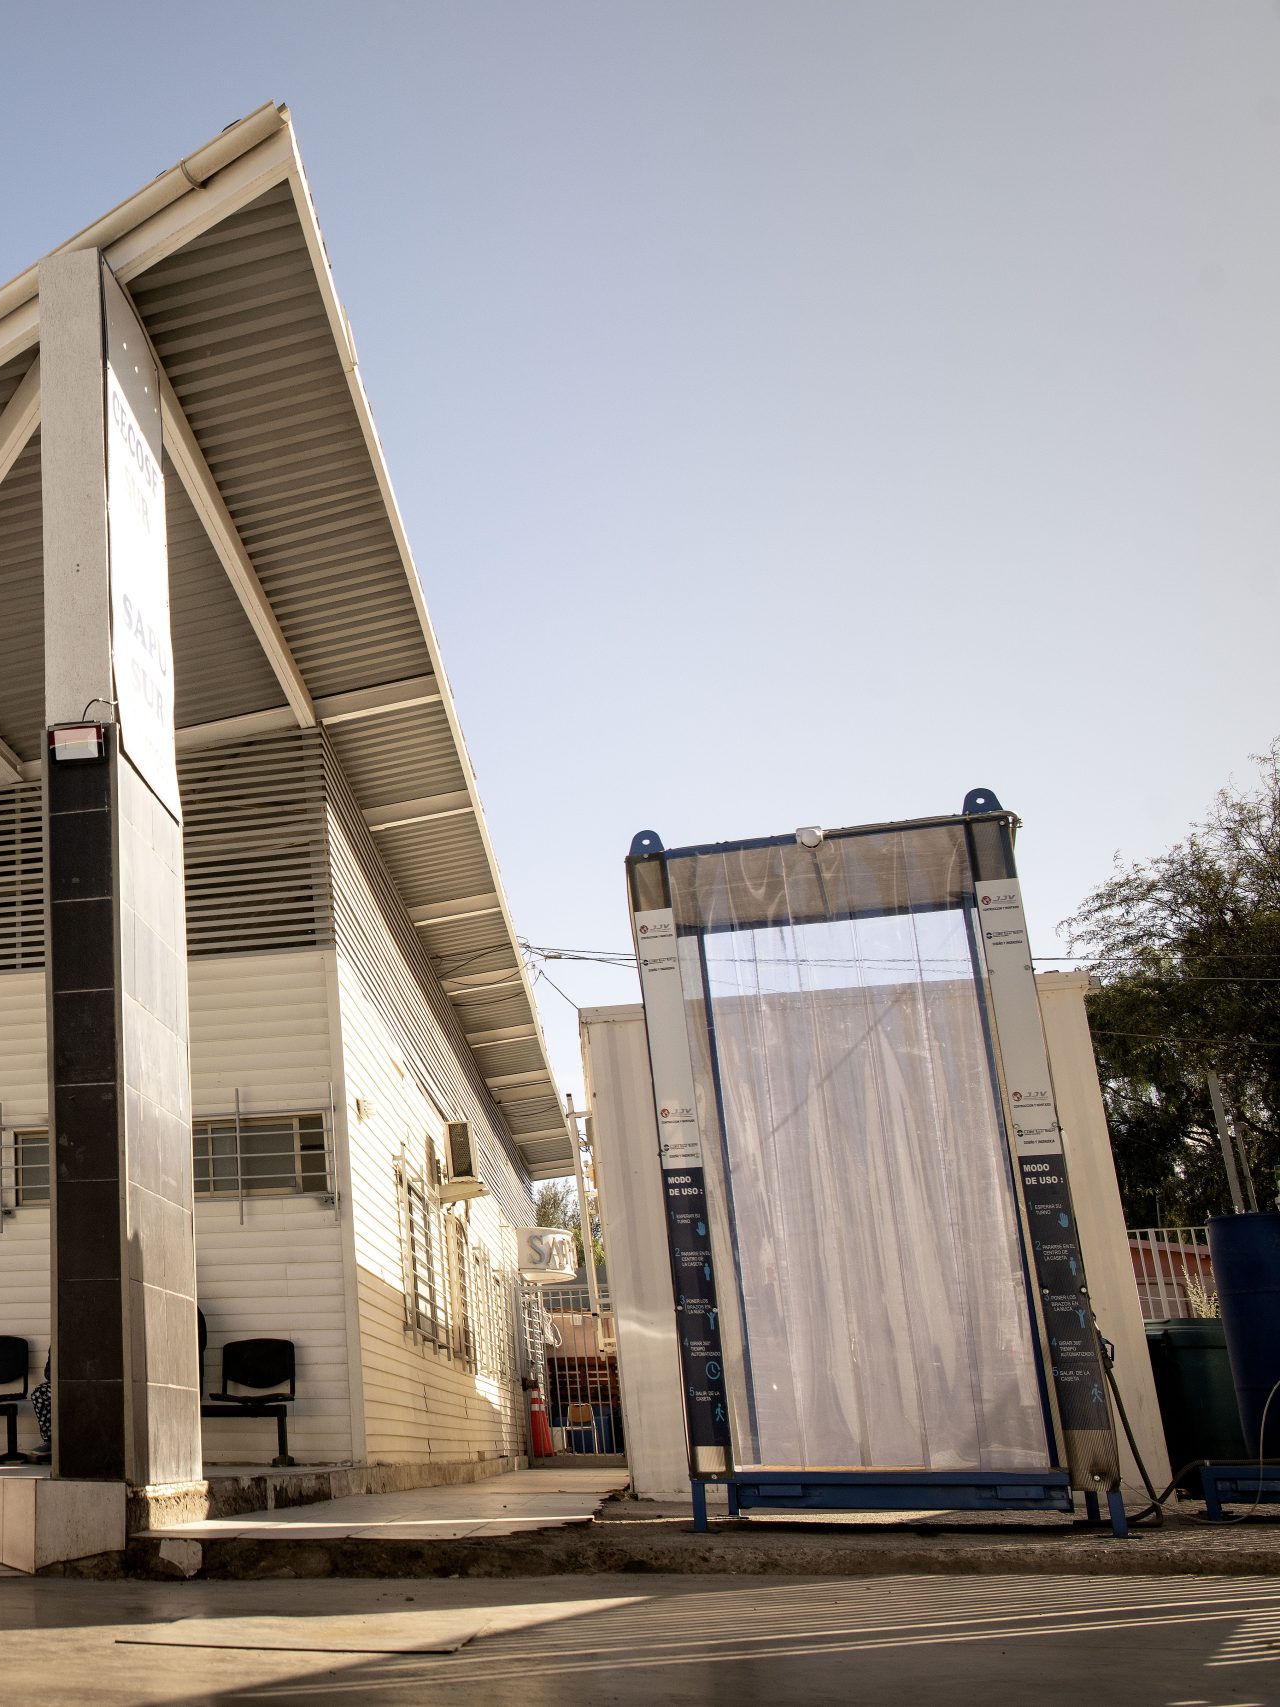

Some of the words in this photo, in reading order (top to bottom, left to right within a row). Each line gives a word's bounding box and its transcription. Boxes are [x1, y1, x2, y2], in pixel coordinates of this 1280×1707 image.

[1023, 1163, 1050, 1172] MODO
[667, 1176, 692, 1184] MODO
[1025, 1177, 1038, 1185] DE
[1039, 1176, 1058, 1184] USO
[668, 1188, 681, 1196] DE
[681, 1187, 699, 1196] USO
[1035, 1240, 1041, 1251] 2
[674, 1247, 680, 1257] 2
[679, 1295, 685, 1305] 3
[683, 1337, 689, 1347] 4
[1051, 1337, 1057, 1347] 4
[1052, 1366, 1059, 1377] 5
[689, 1386, 695, 1397] 5
